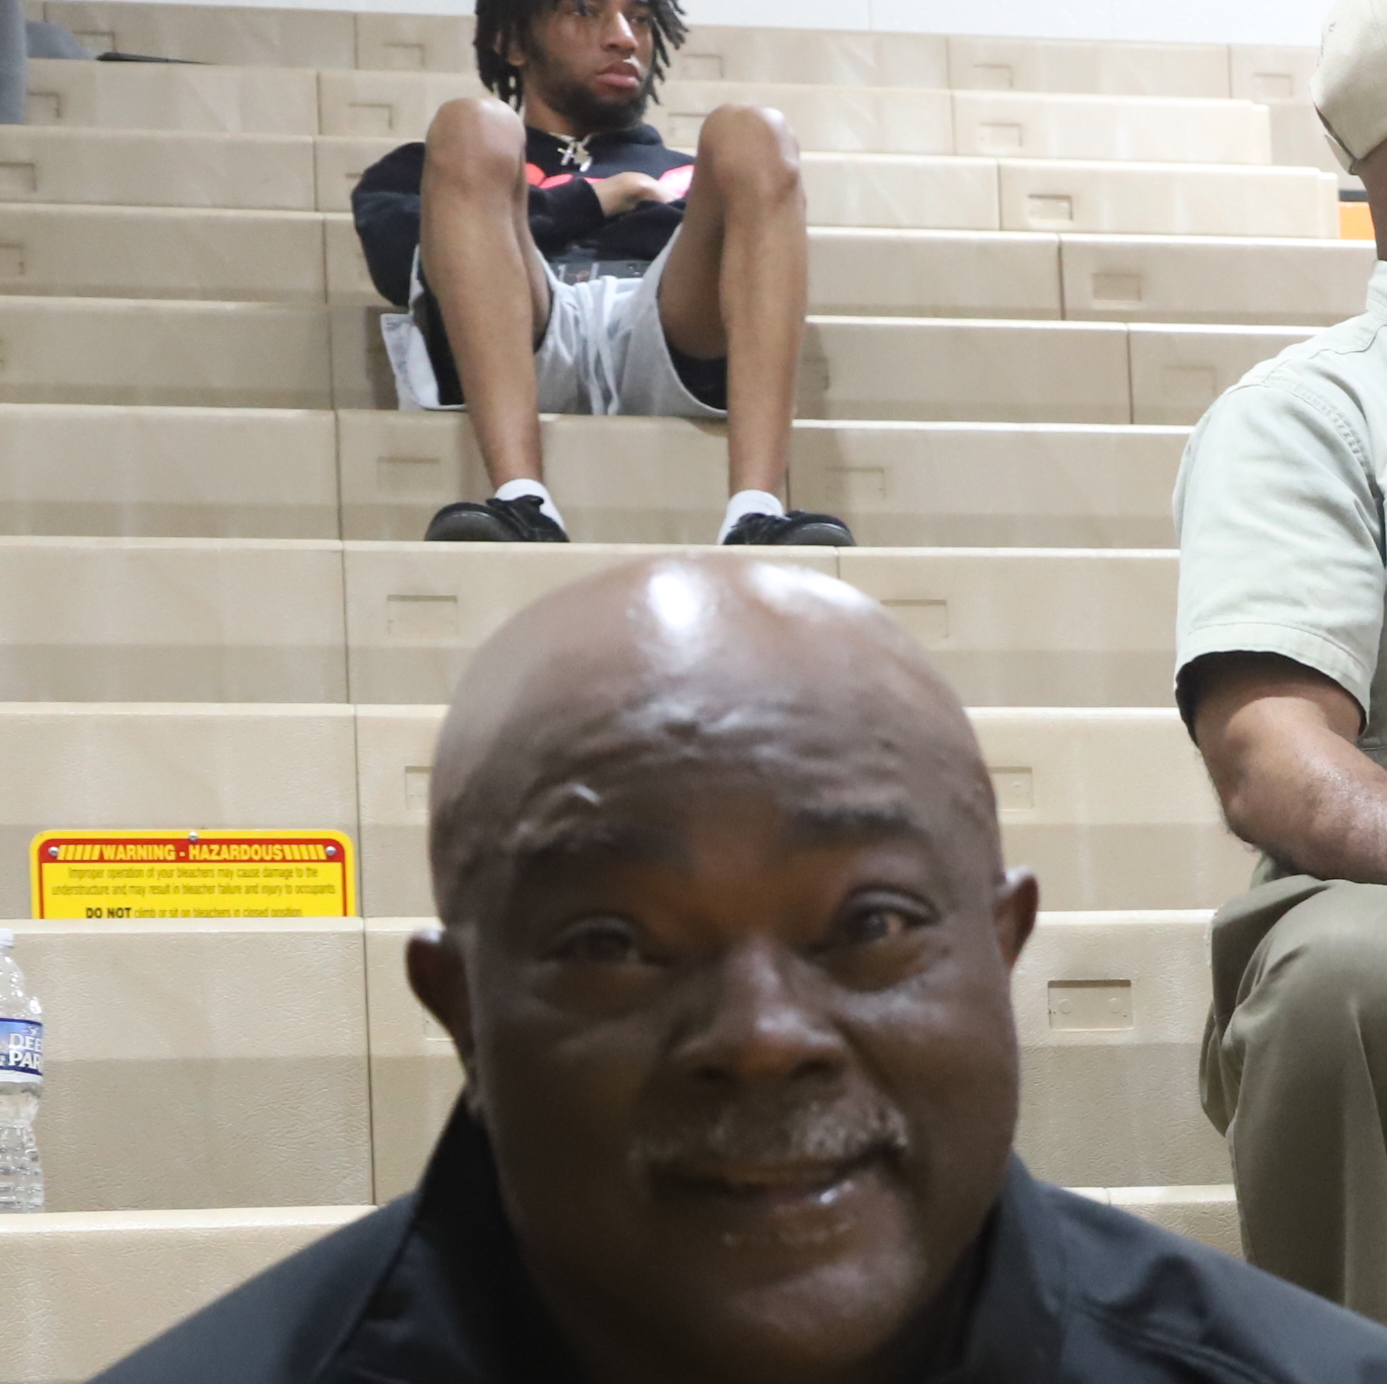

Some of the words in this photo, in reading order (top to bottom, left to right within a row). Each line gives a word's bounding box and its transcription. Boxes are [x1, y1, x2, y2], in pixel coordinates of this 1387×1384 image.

[101, 844, 176, 860] WARNING
[188, 844, 284, 860] HAZARDOUS
[86, 908, 103, 918] DO
[107, 908, 132, 918] NOT
